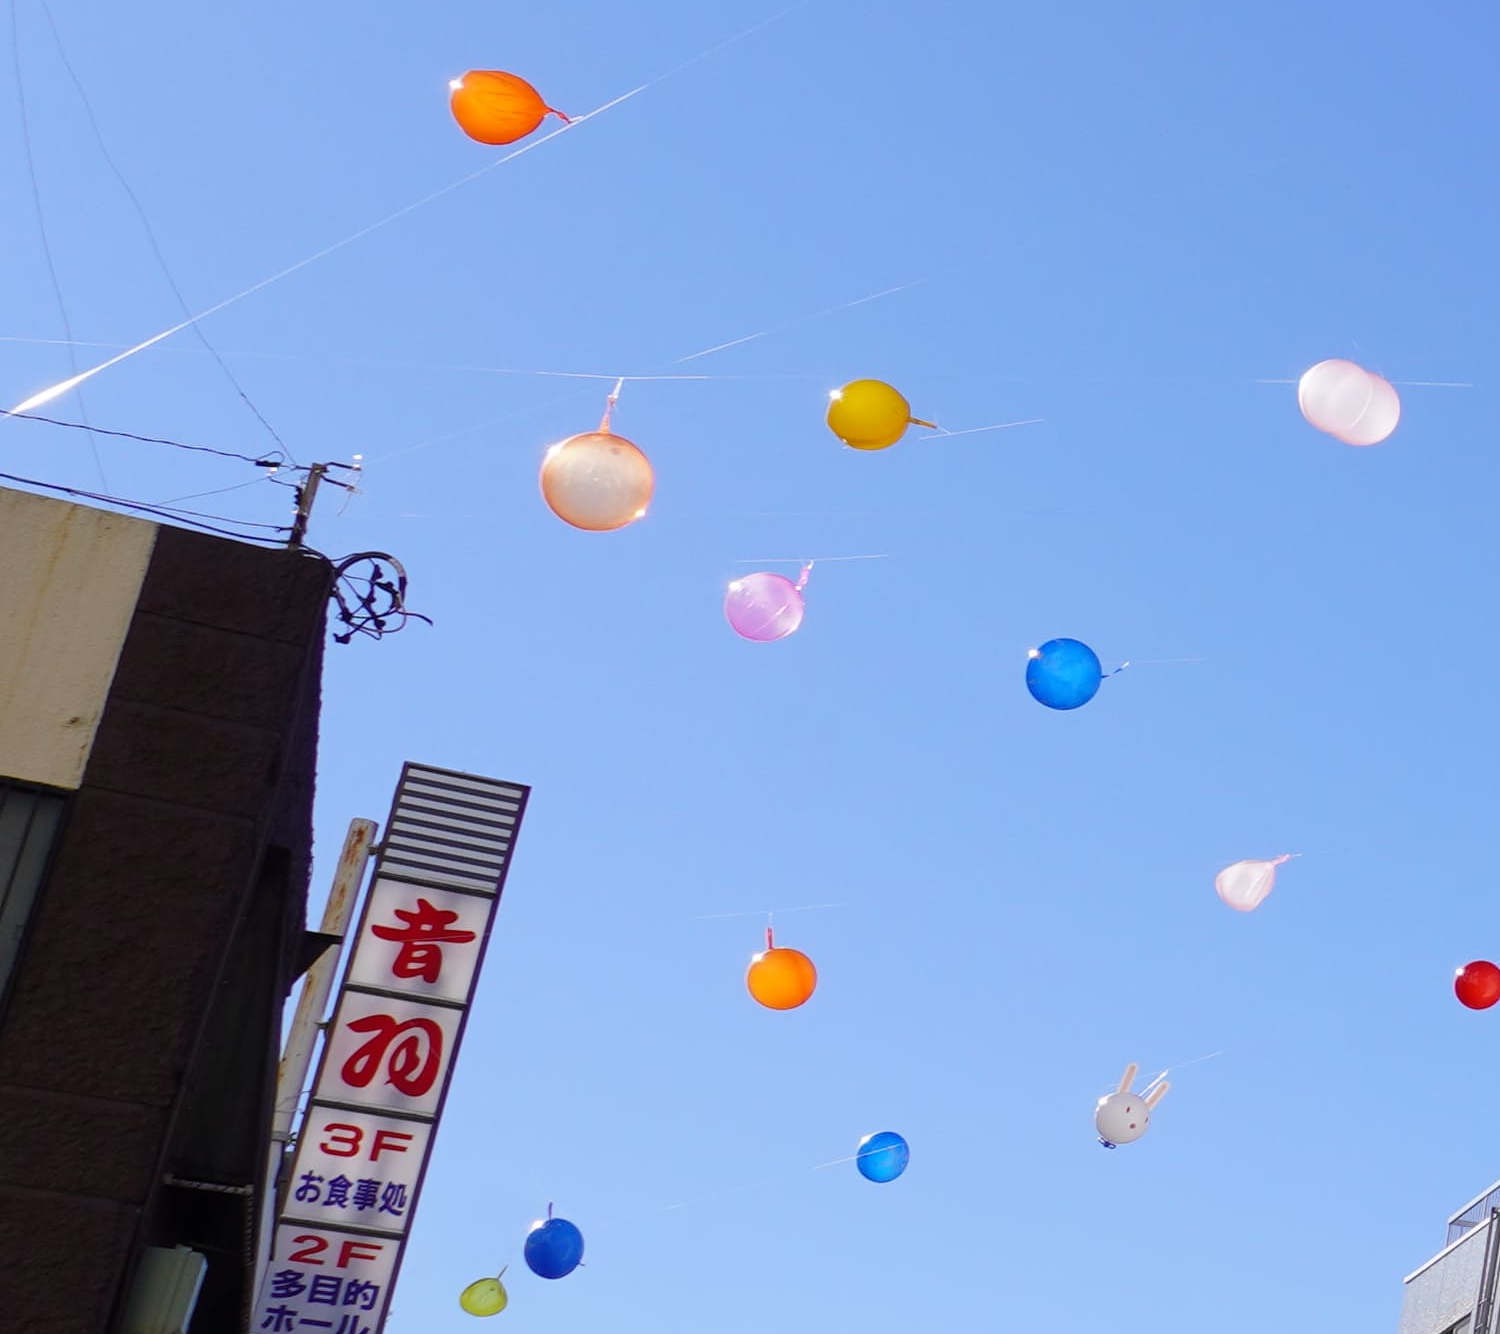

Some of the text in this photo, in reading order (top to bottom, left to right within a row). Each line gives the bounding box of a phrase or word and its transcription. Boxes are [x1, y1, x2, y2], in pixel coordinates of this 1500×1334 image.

[319, 1123, 414, 1162] 3F
[295, 1170, 408, 1216] お食事処
[287, 1235, 384, 1269] 2F
[271, 1269, 381, 1311] 多目的
